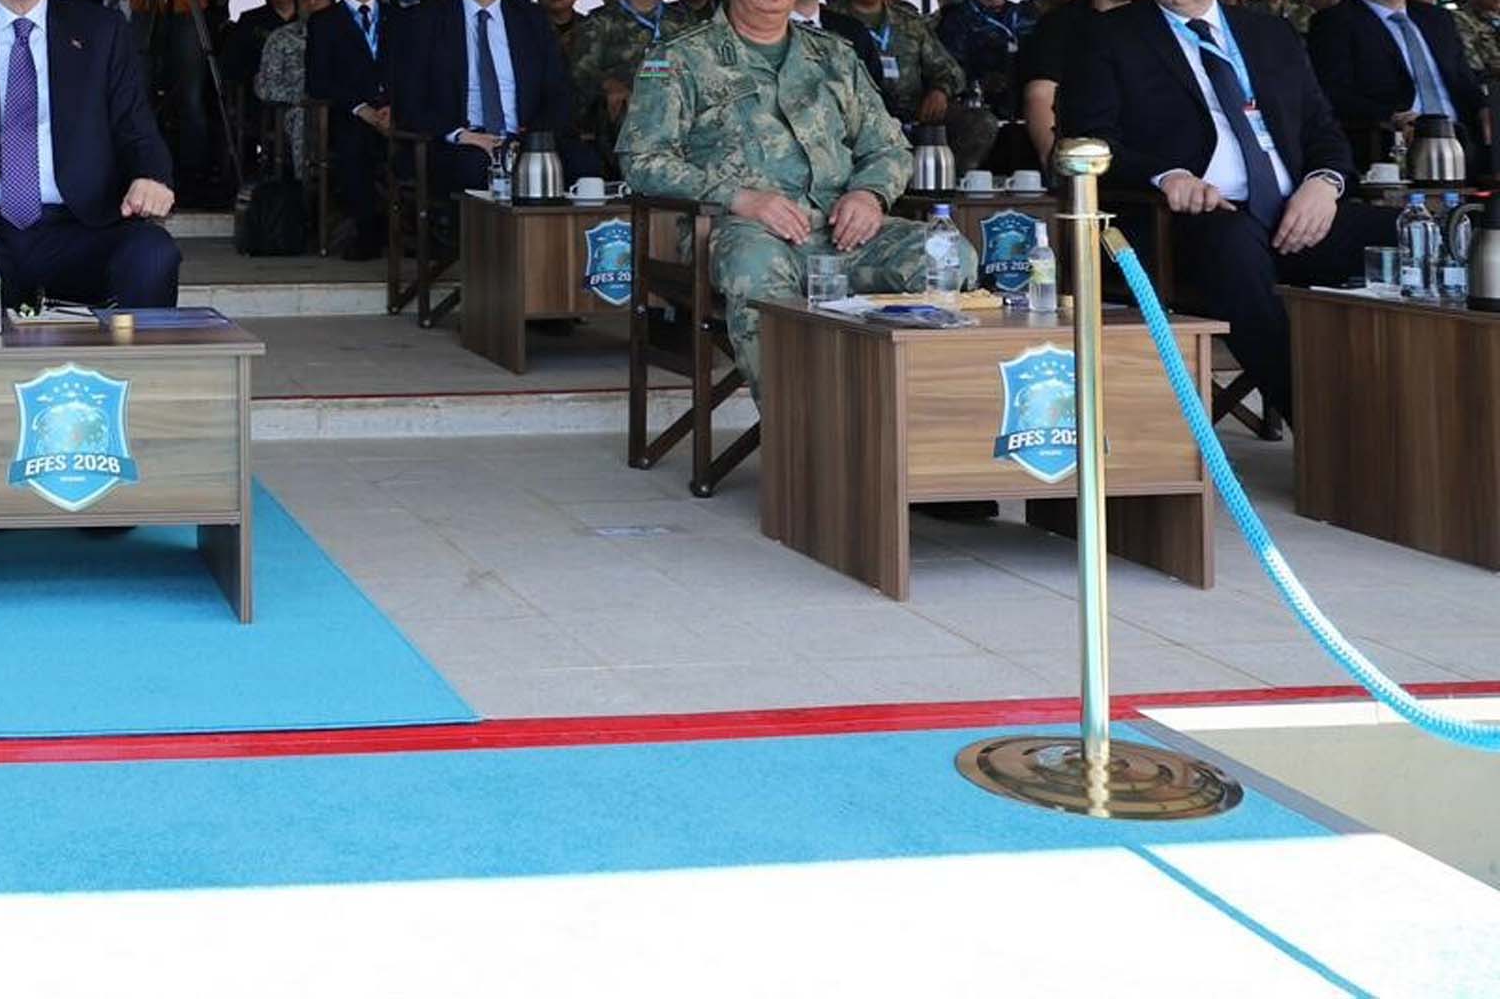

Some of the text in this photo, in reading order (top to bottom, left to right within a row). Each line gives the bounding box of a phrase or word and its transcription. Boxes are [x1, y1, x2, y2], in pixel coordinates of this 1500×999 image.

[617, 271, 631, 281] 20
[1008, 429, 1045, 450] EFES
[25, 455, 67, 476] EFES
